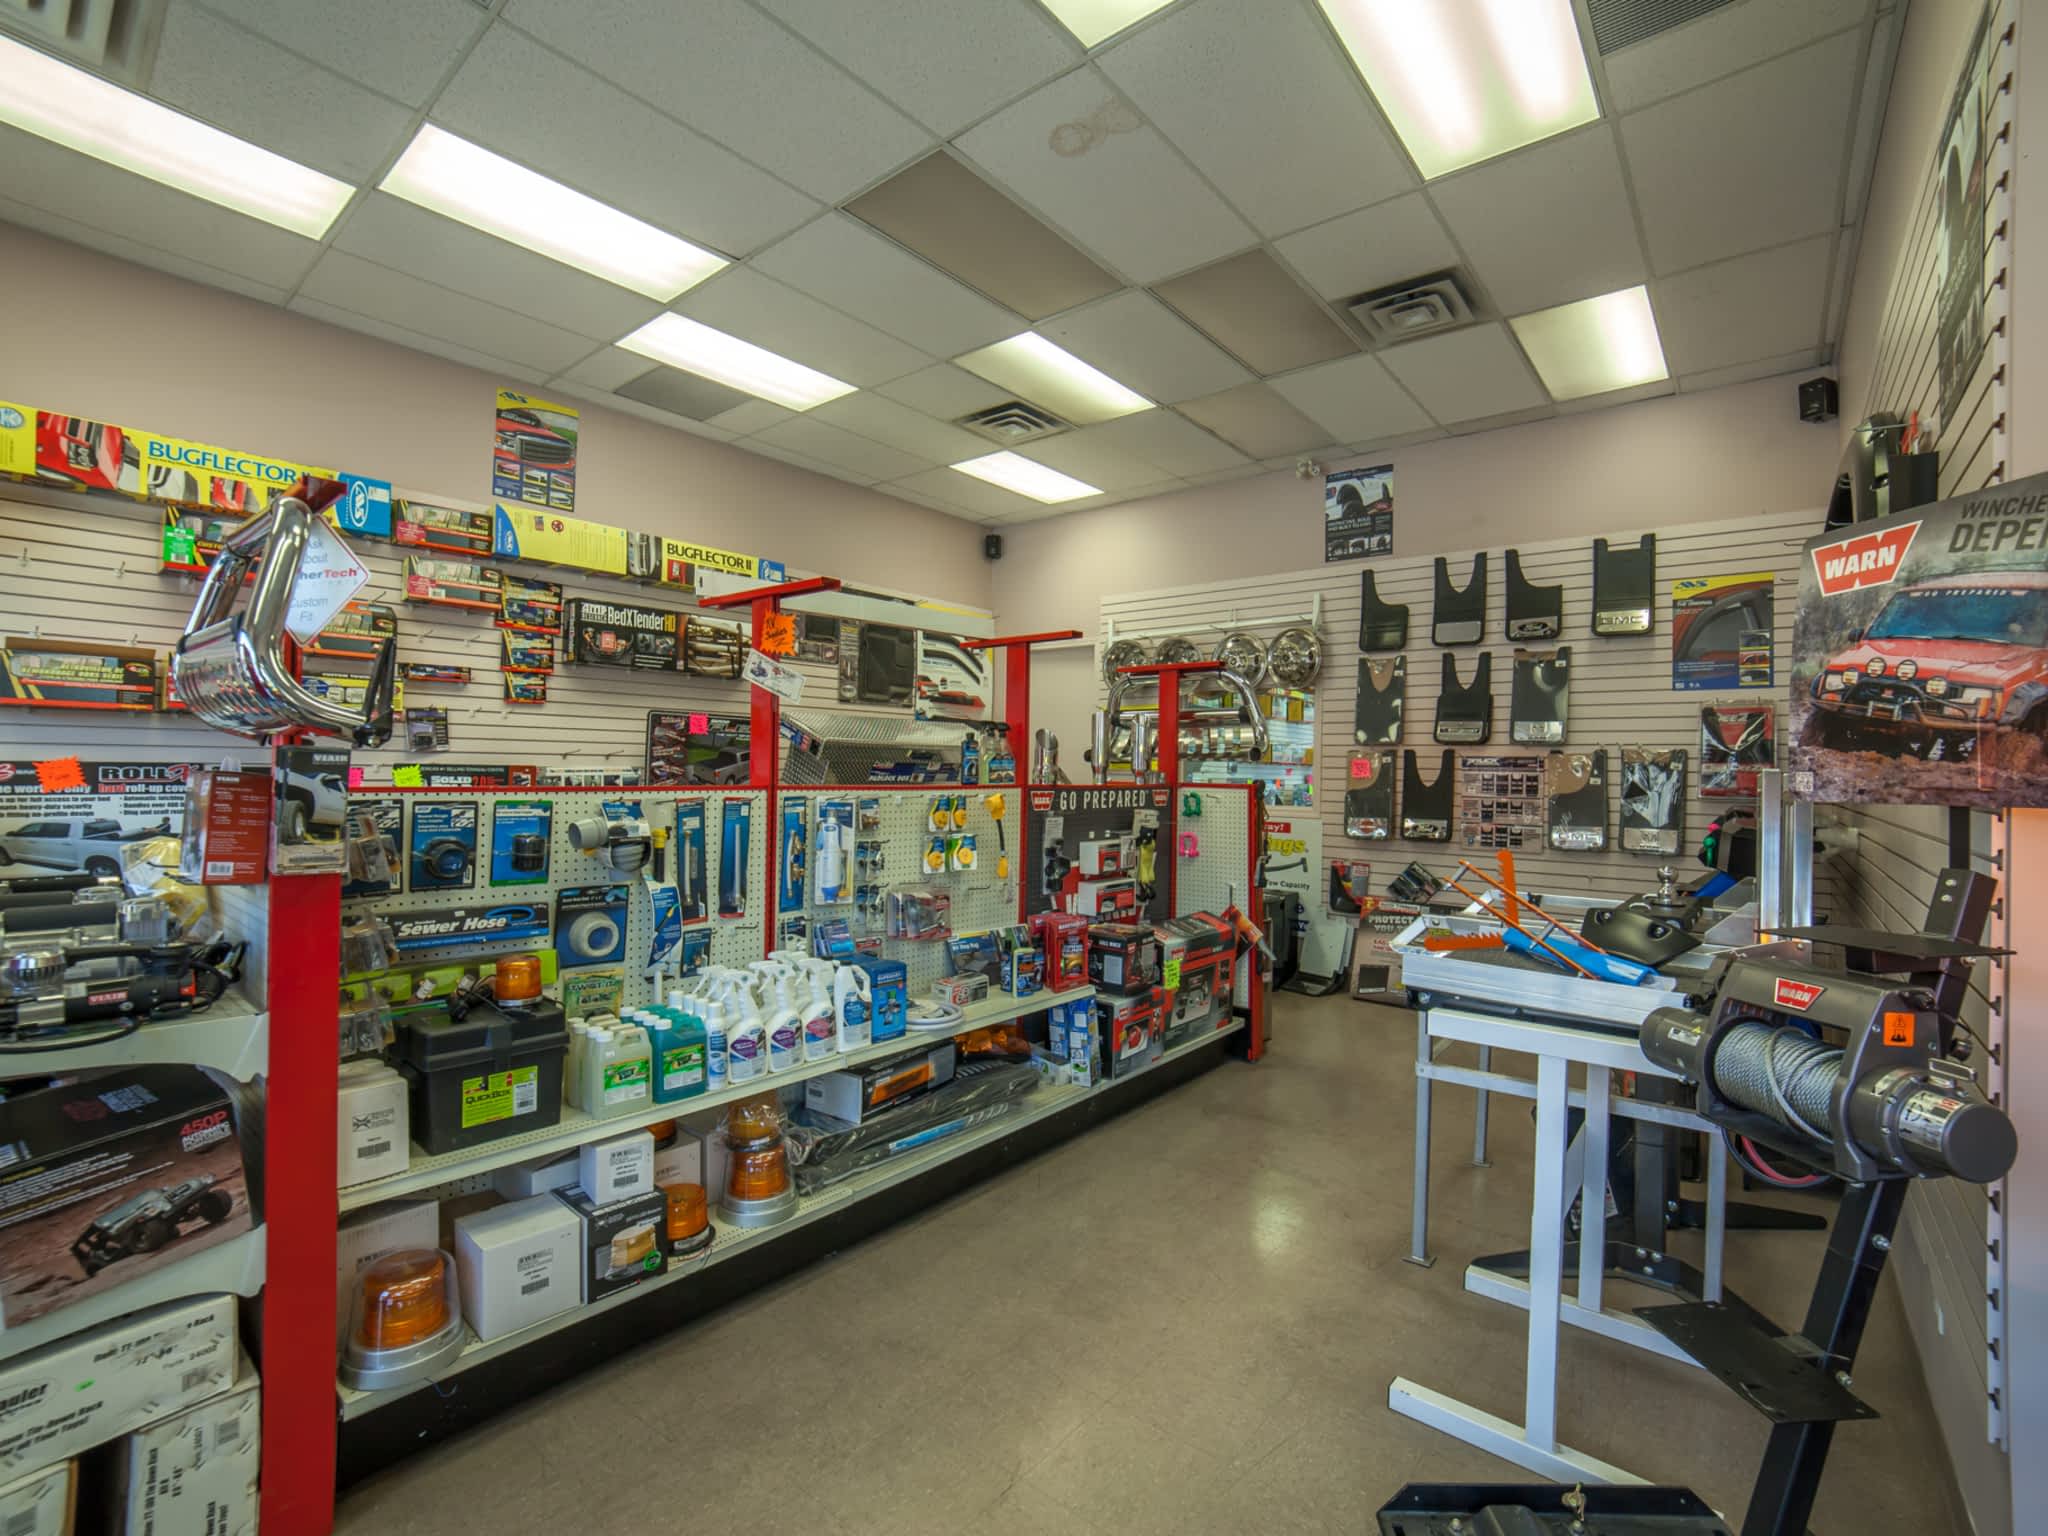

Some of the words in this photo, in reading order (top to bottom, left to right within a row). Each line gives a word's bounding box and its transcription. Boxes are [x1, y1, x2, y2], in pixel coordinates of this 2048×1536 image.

[148, 440, 297, 483] BUGFLECTOR
[666, 542, 744, 569] BUGFLECTOR
[1825, 544, 1898, 580] WARN
[313, 753, 349, 762] VIAIR
[165, 785, 192, 793] cove
[1060, 791, 1077, 810] GO
[1083, 790, 1146, 809] PREPARED
[1280, 880, 1310, 891] Capacity
[398, 919, 461, 937] Sewer
[463, 917, 507, 931] Hose
[1368, 915, 1414, 924] PROTECT
[1779, 985, 1814, 1003] WARN
[180, 1110, 229, 1138] 450P
